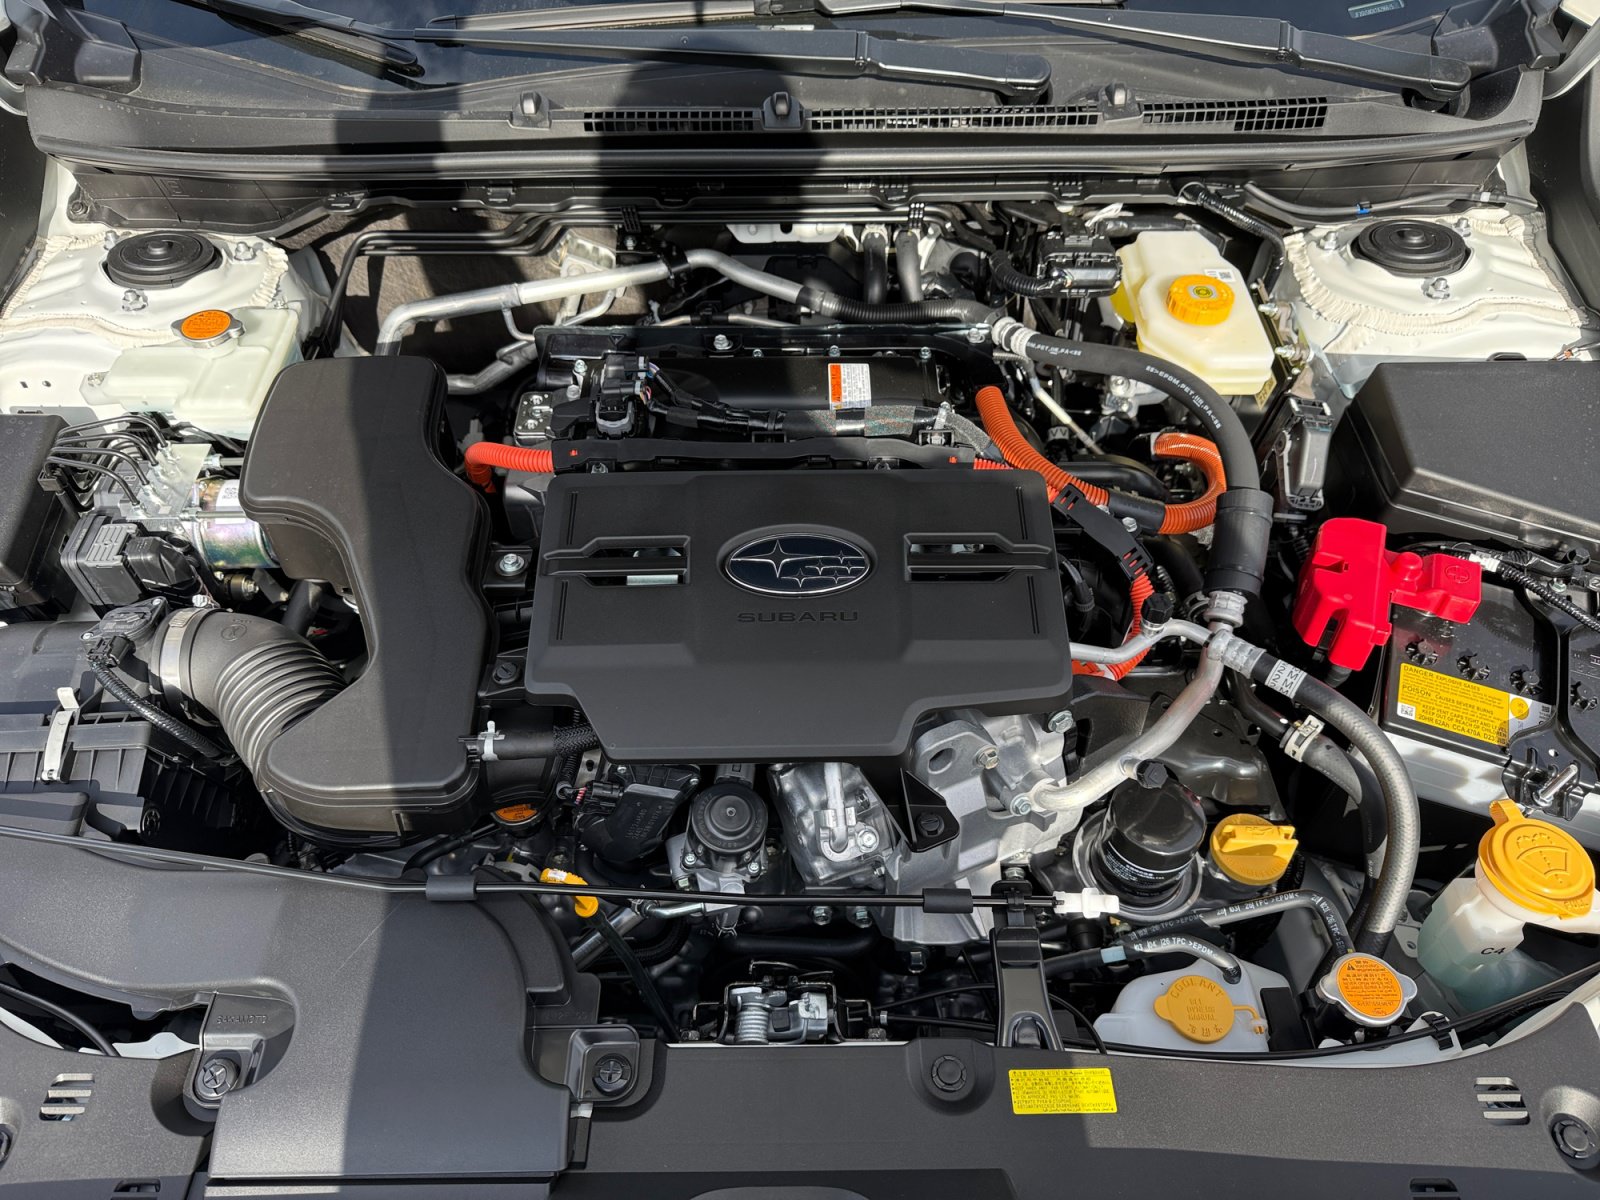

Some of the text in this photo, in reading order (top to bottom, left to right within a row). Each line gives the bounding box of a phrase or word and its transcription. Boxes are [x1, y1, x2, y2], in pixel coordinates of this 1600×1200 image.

[738, 611, 858, 623] SUBARU
[1287, 671, 1299, 681] M
[1403, 666, 1434, 678] DANGER
[1282, 679, 1294, 689] M
[1402, 685, 1431, 697] POISON
[1435, 695, 1455, 704] CAUSES
[1475, 706, 1494, 715] BURNS
[1452, 724, 1466, 732] CCA
[1455, 719, 1473, 727] REACH
[1172, 936, 1186, 945] TPC
[1481, 947, 1506, 955] C4
[1170, 978, 1224, 999] COOLANT
